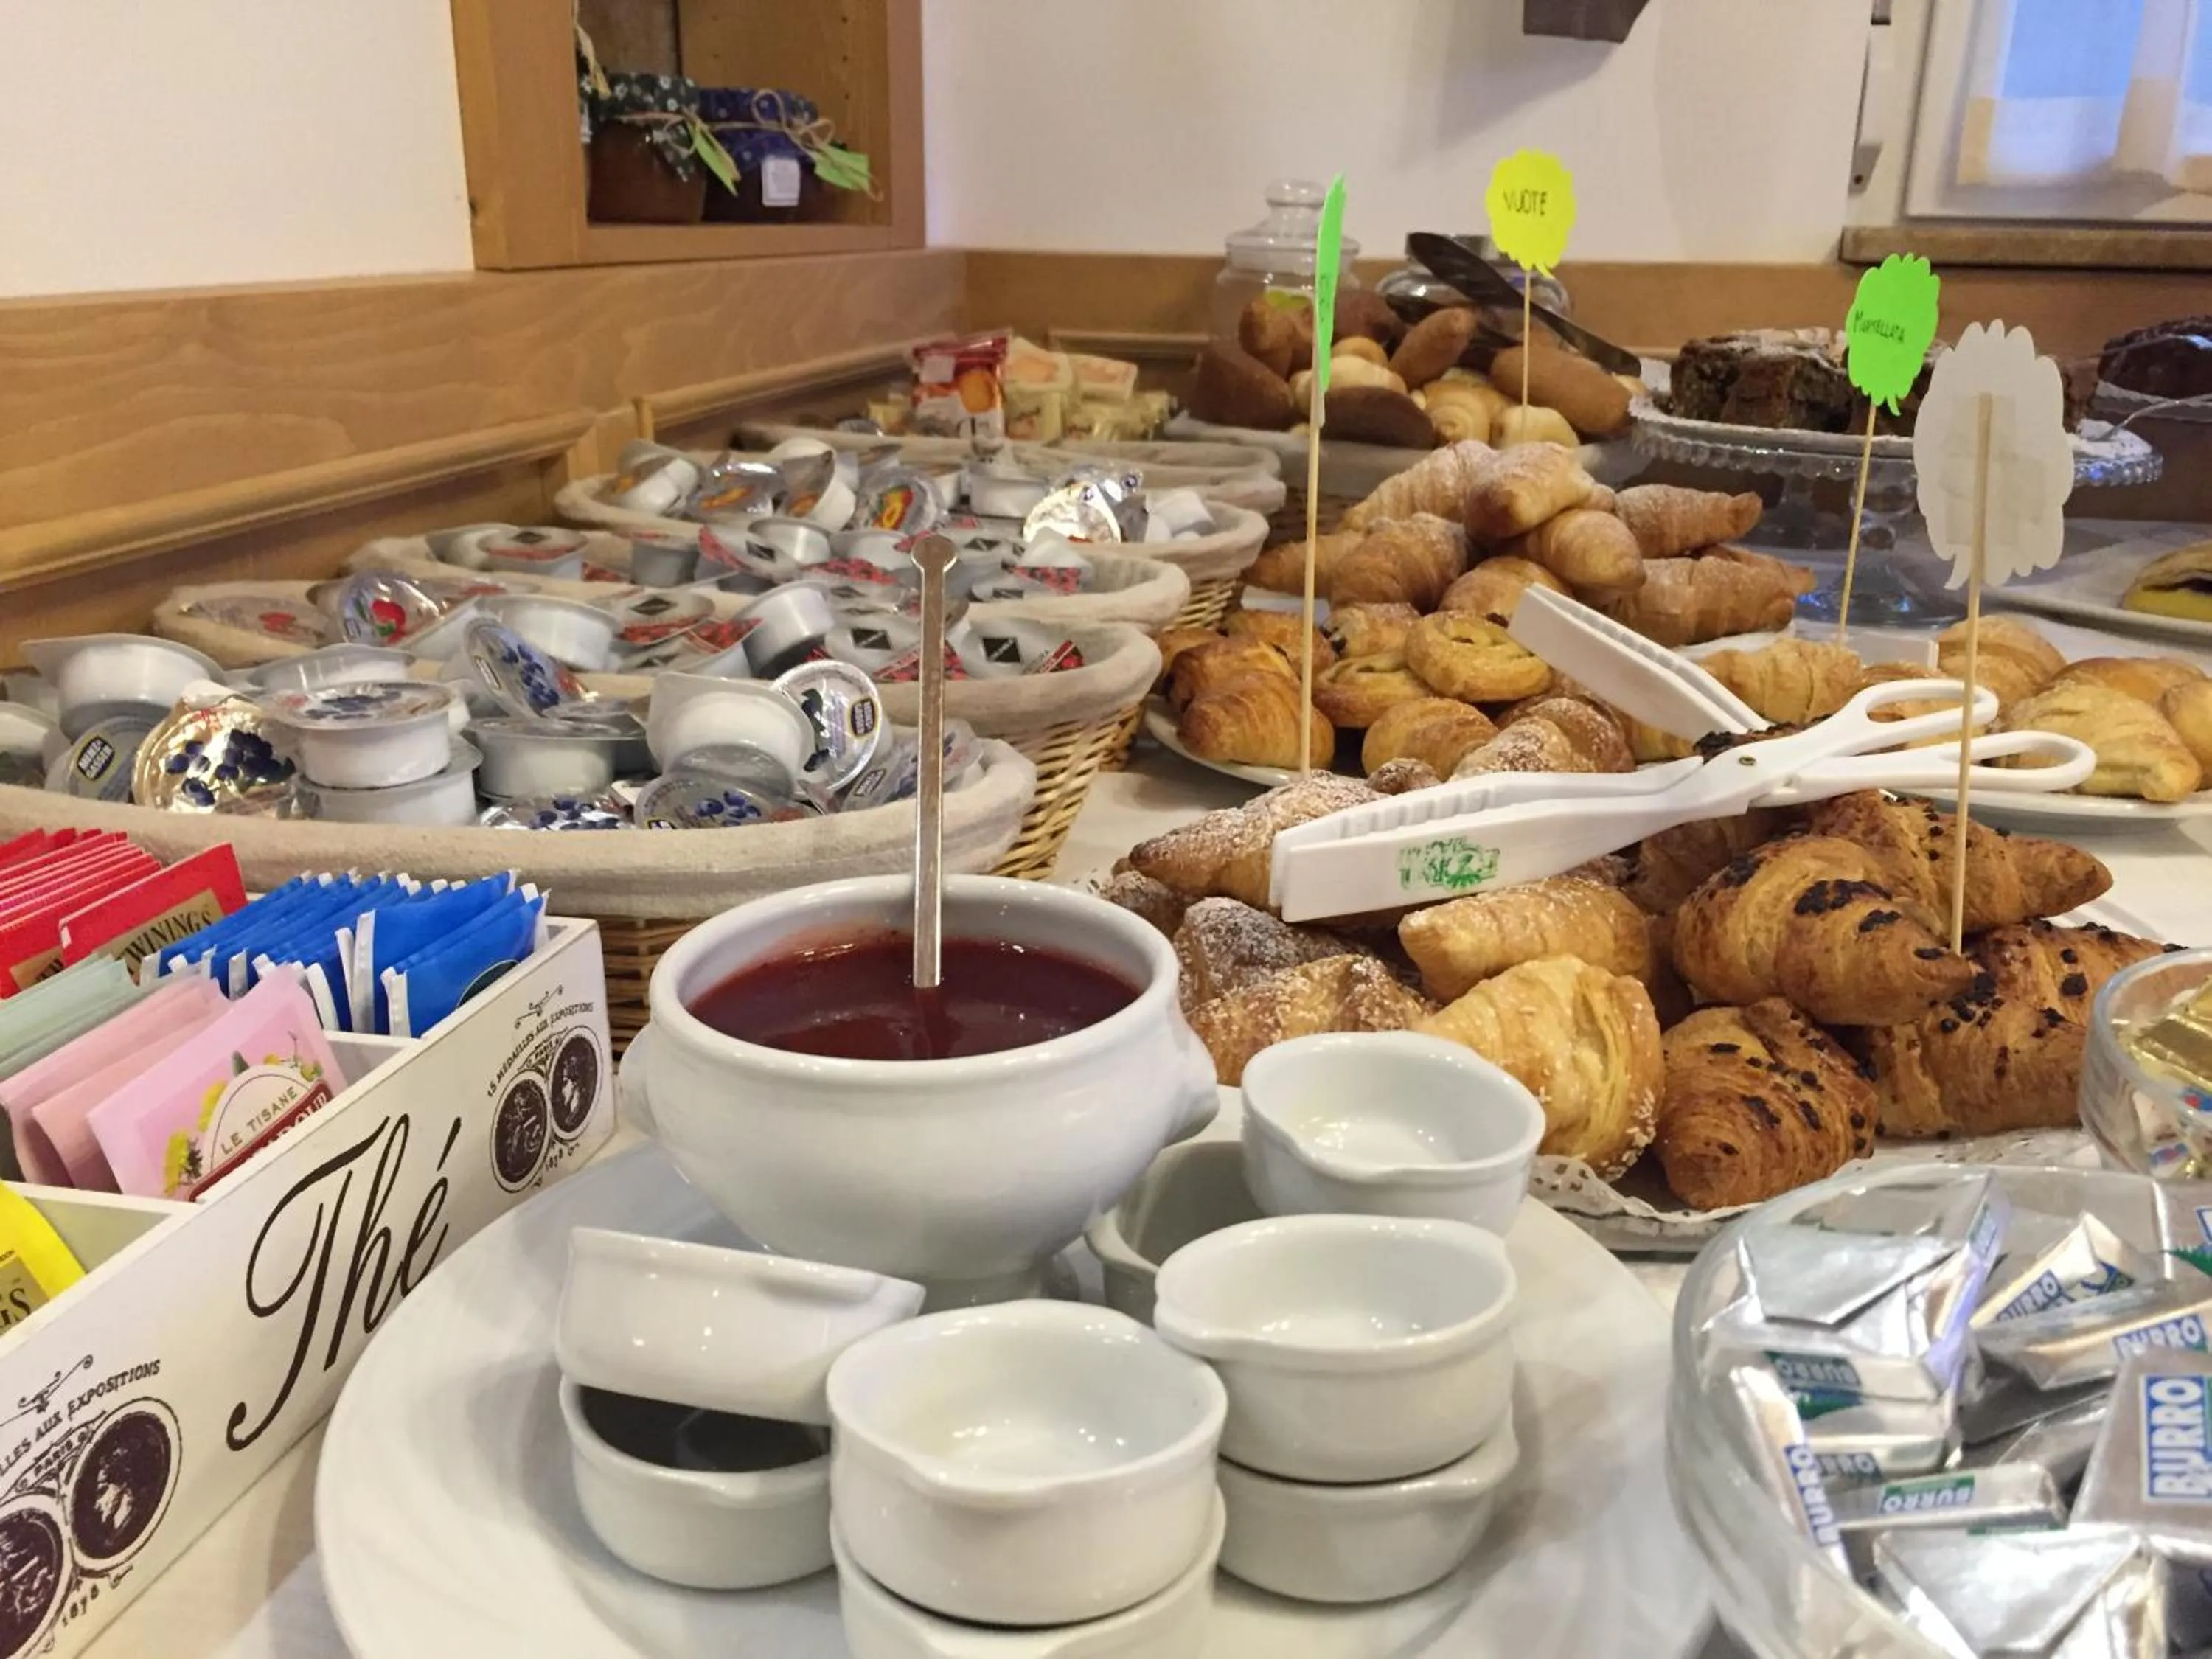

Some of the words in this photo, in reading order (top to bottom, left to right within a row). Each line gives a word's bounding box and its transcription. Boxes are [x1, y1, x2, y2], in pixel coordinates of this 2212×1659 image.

[115, 908, 213, 977] WININGS
[221, 1131, 243, 1155] LE
[246, 1086, 298, 1133] TISANE
[226, 1113, 462, 1451] Thé
[67, 1358, 161, 1422] EXPOSITIONS
[2149, 1378, 2211, 1496] BURRO
[1790, 1447, 1841, 1544] BURRO
[1882, 1486, 1971, 1512] BURRO
